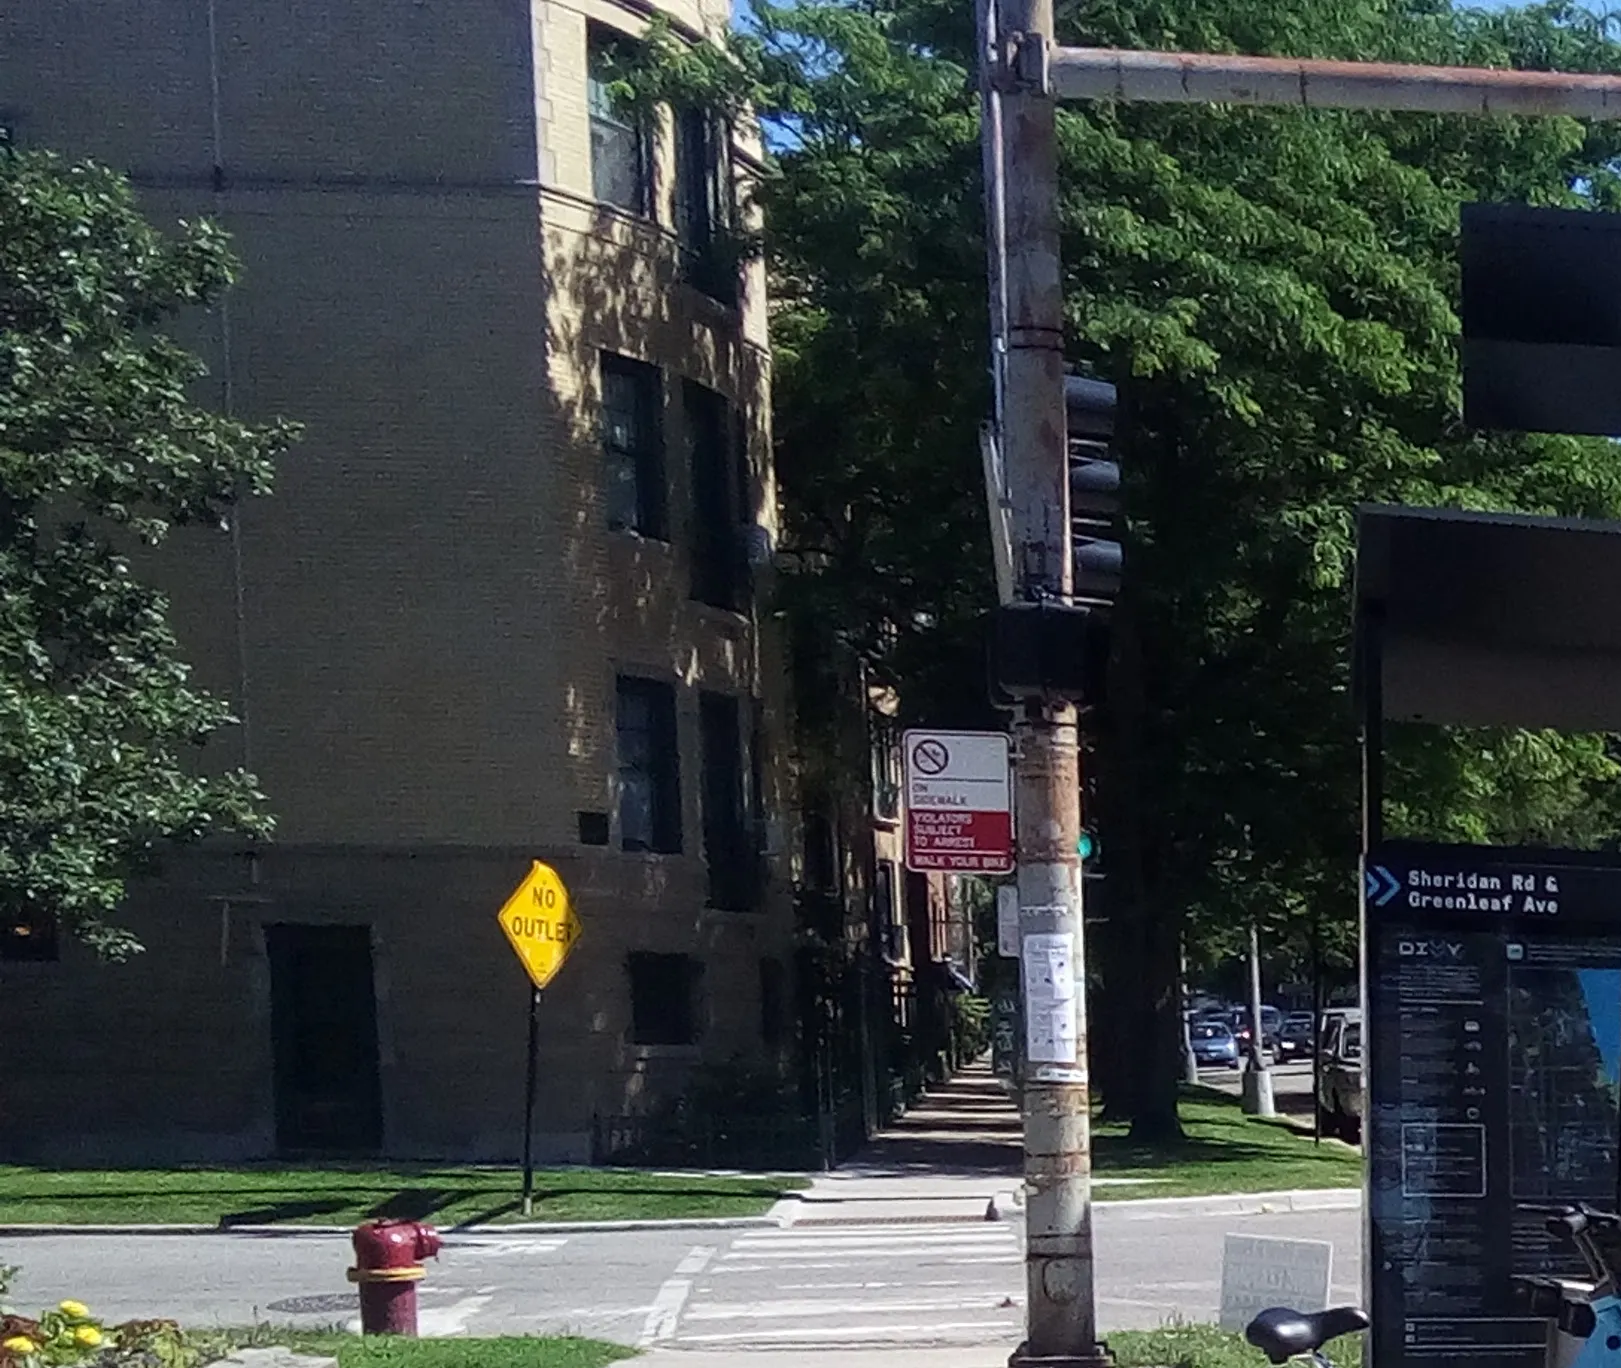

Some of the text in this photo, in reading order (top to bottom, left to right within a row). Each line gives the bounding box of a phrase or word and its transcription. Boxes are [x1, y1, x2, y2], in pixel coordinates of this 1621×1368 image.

[913, 835, 975, 848] TO ARREST
[1408, 870, 1559, 893] Sheridan Rd &
[532, 886, 555, 909] NO
[1408, 891, 1558, 914] Greenleaf Ave
[512, 917, 572, 942] OUTLET
